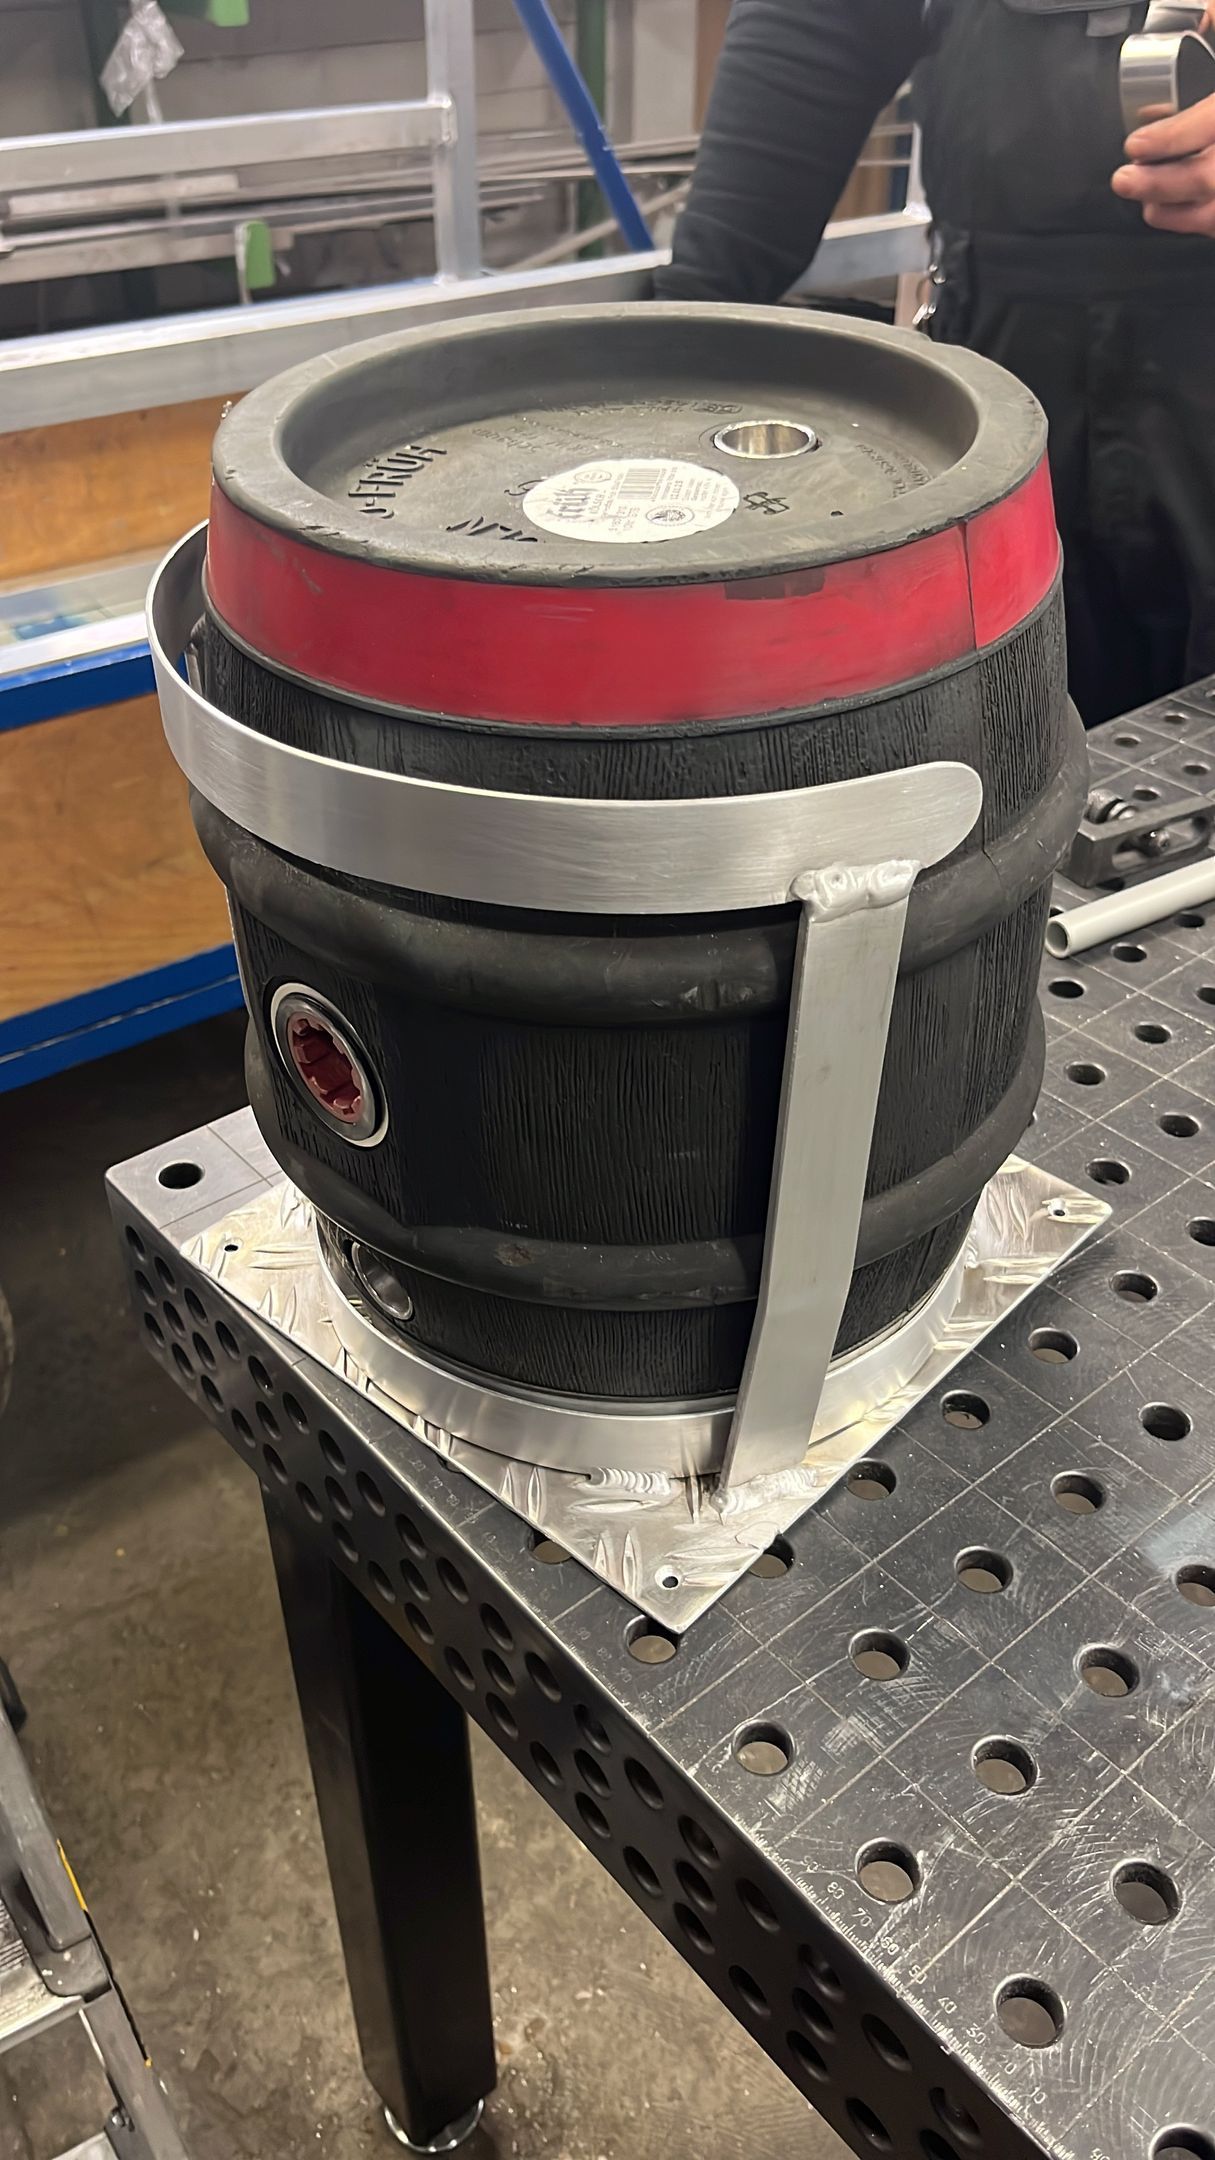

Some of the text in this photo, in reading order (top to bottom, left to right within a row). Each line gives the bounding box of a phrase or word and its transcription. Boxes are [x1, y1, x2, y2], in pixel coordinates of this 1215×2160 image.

[826, 1881, 845, 1900] 80
[851, 1907, 872, 1927] 70
[881, 1936, 900, 1956] 60
[908, 1964, 928, 1984] 50
[937, 1996, 958, 2015] 40
[965, 2023, 987, 2045] 30
[1030, 2086, 1047, 2105] 10
